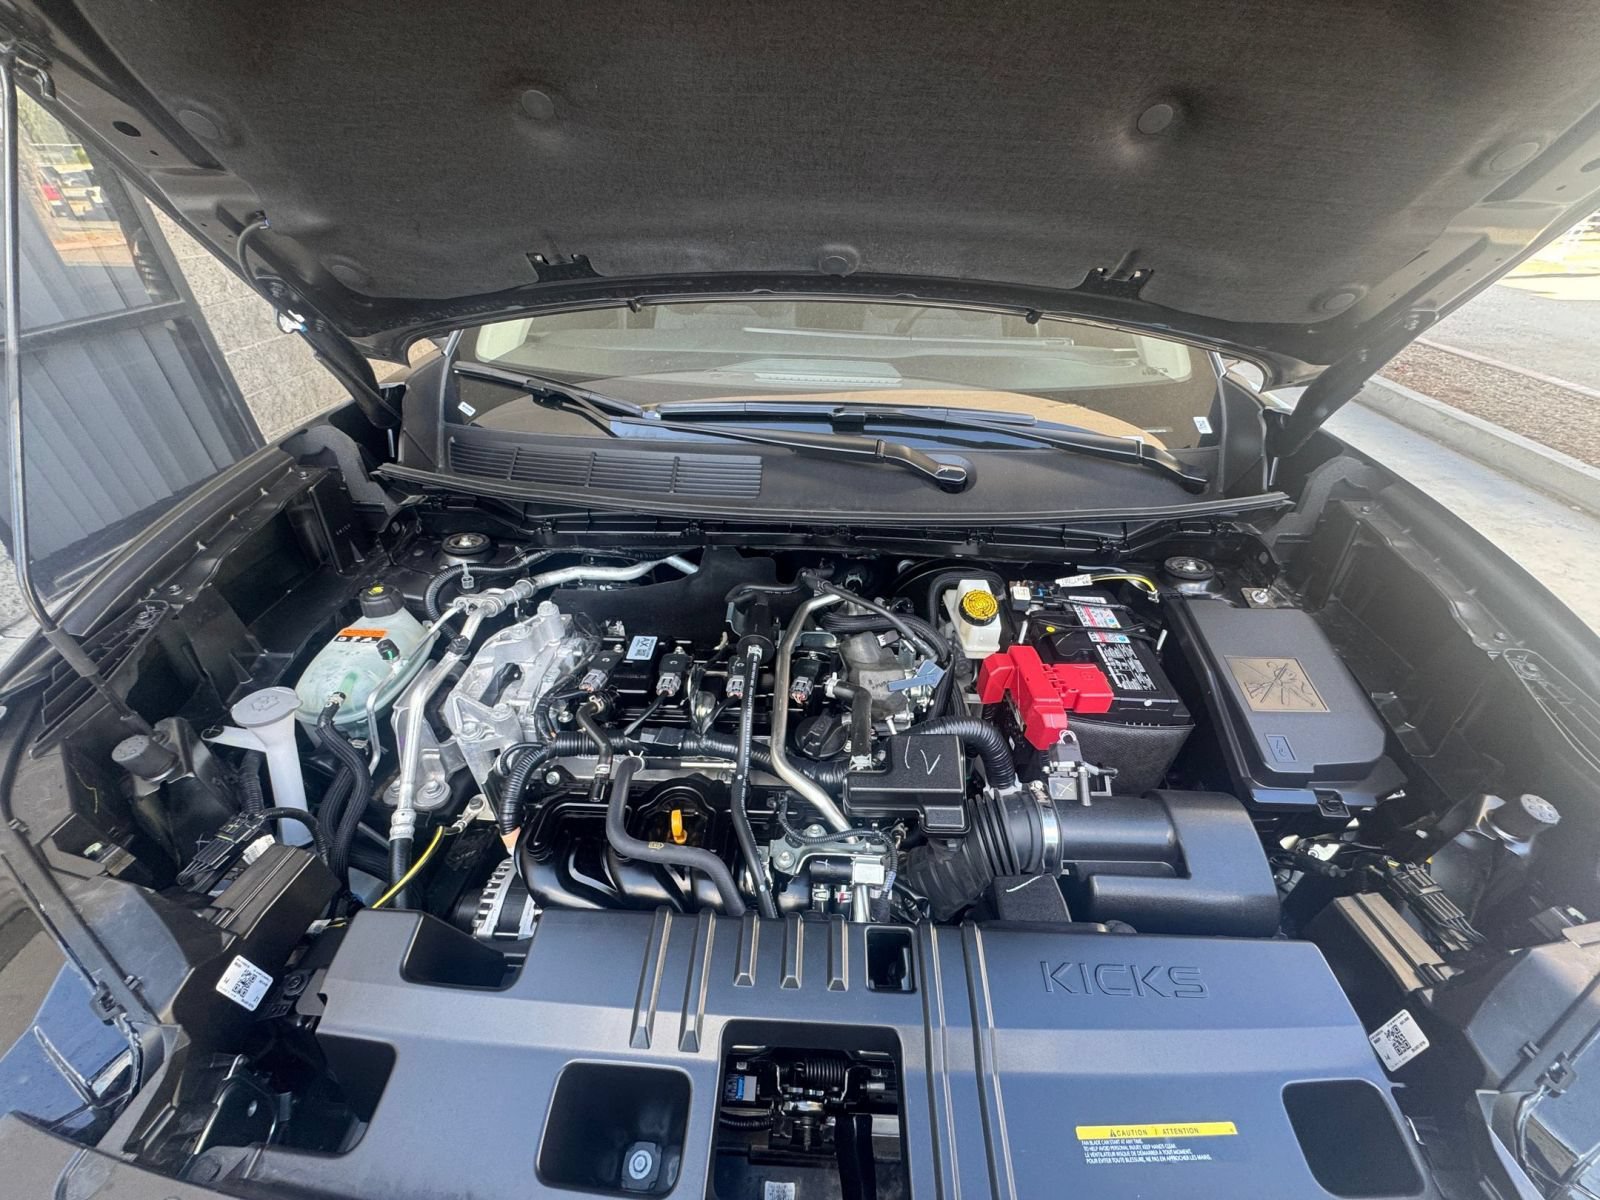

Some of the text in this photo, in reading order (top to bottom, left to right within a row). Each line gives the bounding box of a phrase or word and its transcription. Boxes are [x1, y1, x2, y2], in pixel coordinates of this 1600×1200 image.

[1040, 961, 1209, 998] KICKS
[1116, 1127, 1200, 1137] CAUTION ATTENTION
